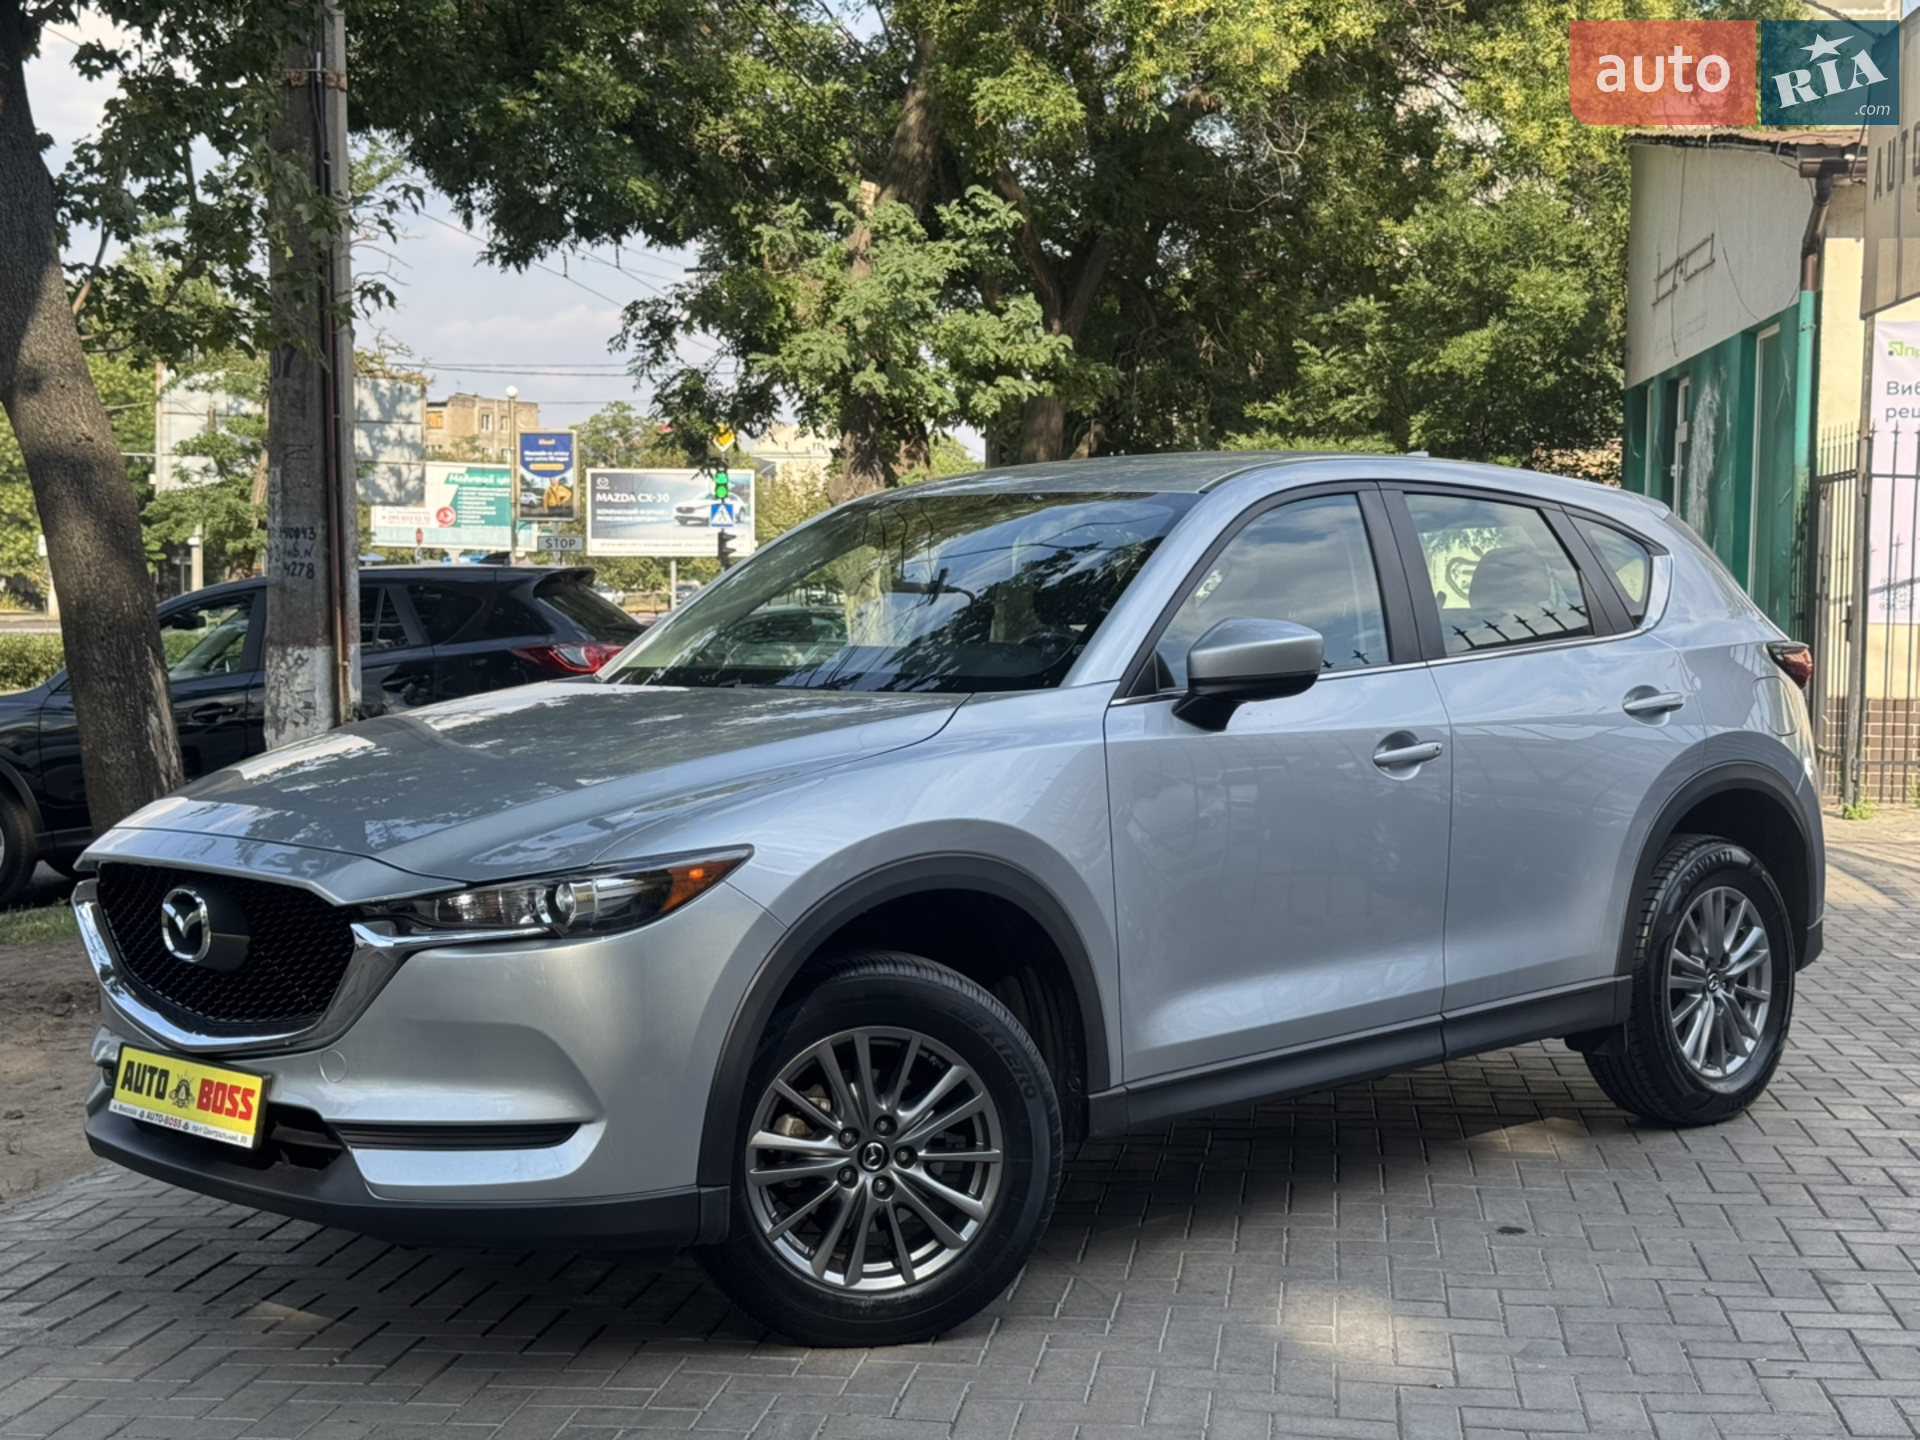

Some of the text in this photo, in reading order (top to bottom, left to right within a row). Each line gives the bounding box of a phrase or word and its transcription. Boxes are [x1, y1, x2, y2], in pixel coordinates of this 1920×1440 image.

[596, 492, 670, 503] MAZDA CX-30
[545, 537, 576, 549] STOP
[284, 561, 315, 579] 4278
[1687, 850, 1733, 879] DAVANTI
[120, 1060, 256, 1122] AUTO BOSS
[146, 1111, 182, 1128] AUTO-BOSS
